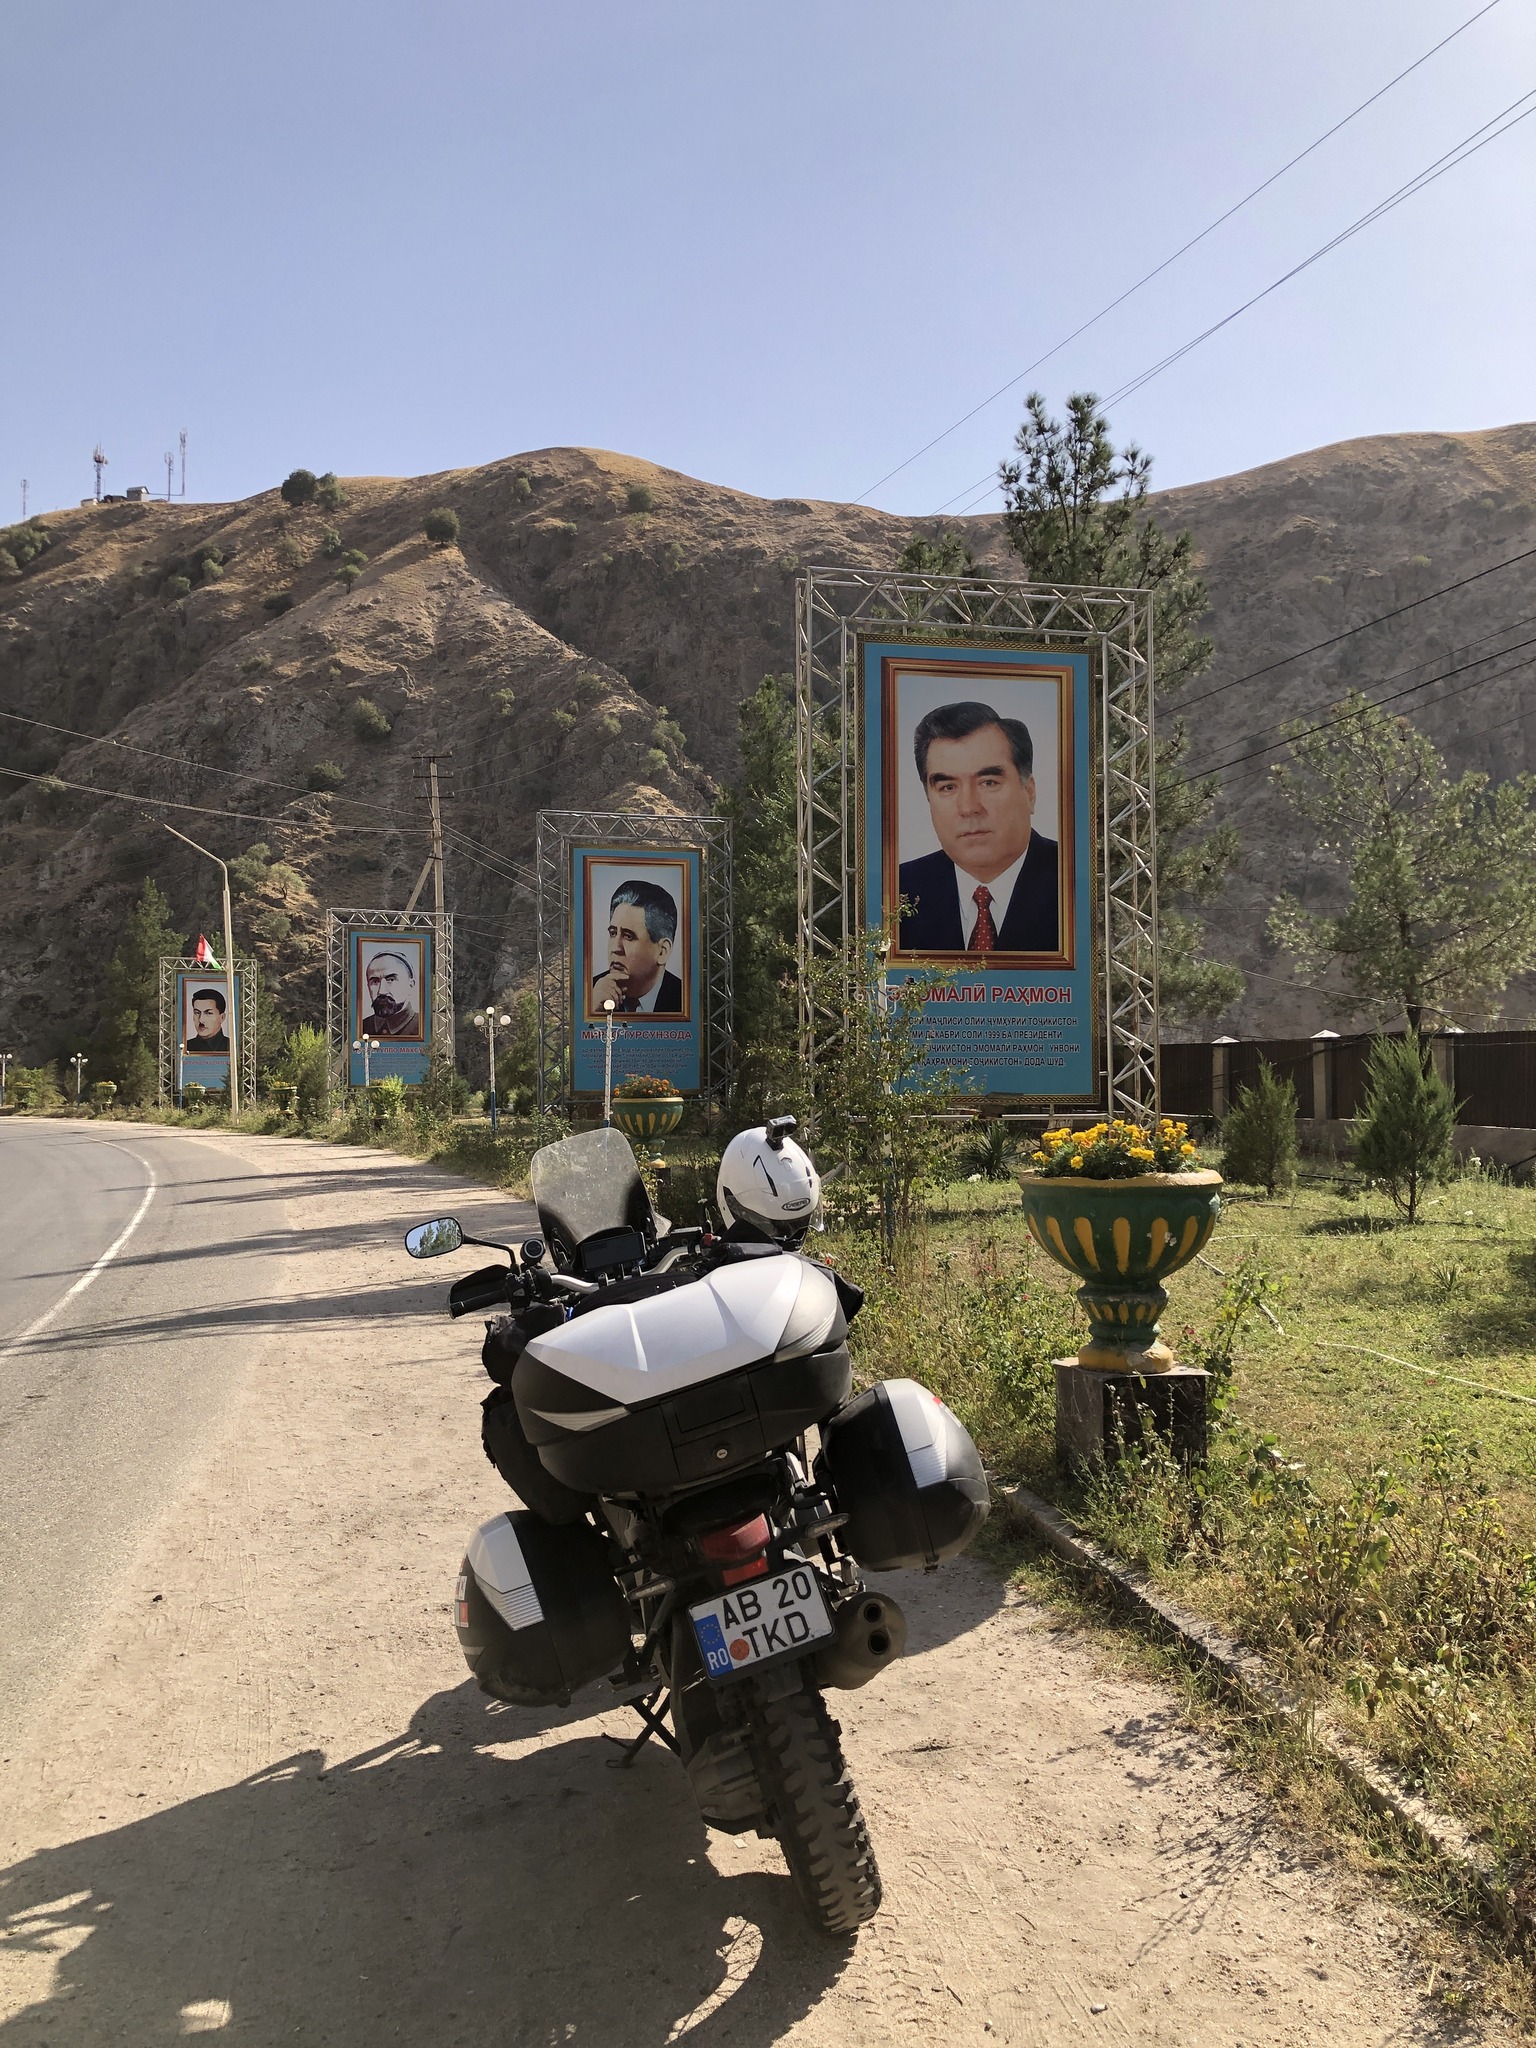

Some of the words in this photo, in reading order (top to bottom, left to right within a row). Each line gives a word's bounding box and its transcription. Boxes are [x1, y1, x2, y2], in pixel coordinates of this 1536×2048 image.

[887, 983, 985, 1003] ЭОМАЛӢ
[991, 986, 1072, 1005] РАҲМОН
[582, 1030, 619, 1039] МИРО
[961, 1030, 983, 1039] СОЛИ
[984, 1030, 1000, 1039] 1999
[1002, 1030, 1013, 1039] БА
[1013, 1030, 1062, 1040] ПРЕЗИДЕНТИ
[1012, 1044, 1044, 1053] РАҲМОН
[1049, 1044, 1080, 1053] УНВОНИ
[1024, 1057, 1045, 1067] ДОДА
[722, 1589, 762, 1629] AB
[772, 1570, 812, 1609] 20
[742, 1611, 811, 1659] TKD
[706, 1647, 729, 1671] RO
